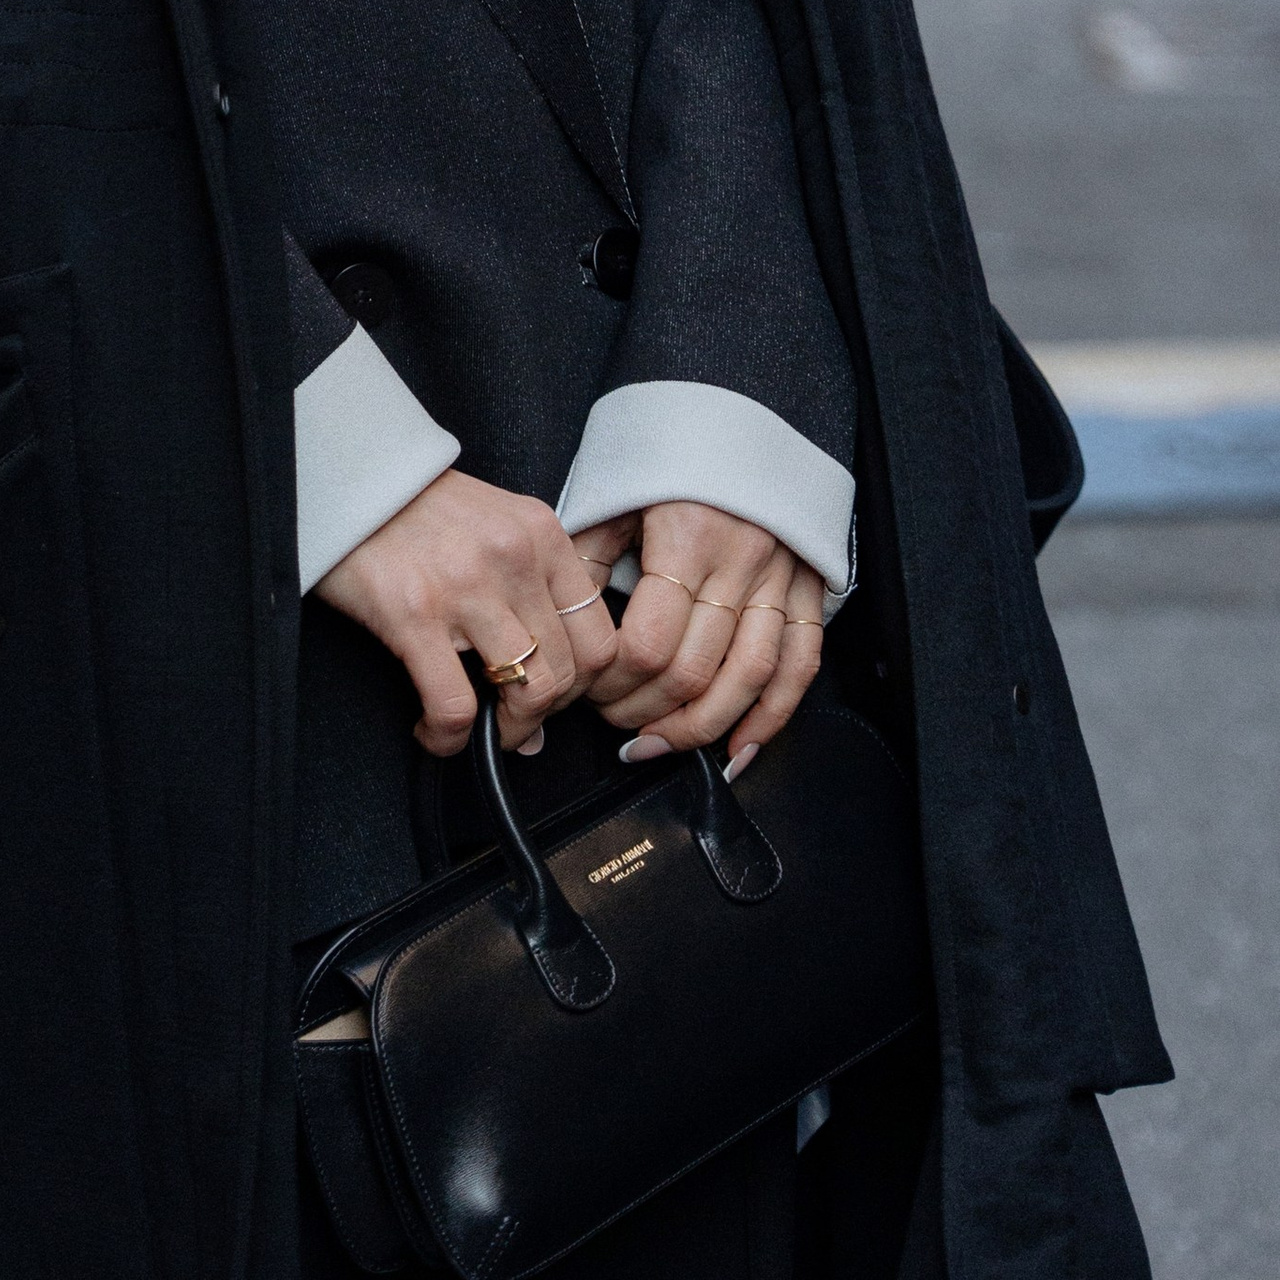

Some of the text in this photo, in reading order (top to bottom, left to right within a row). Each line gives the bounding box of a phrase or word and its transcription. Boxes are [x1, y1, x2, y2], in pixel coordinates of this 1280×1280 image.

[588, 839, 654, 883] GIORGIO ARMANI
[610, 860, 645, 883] MILANO
